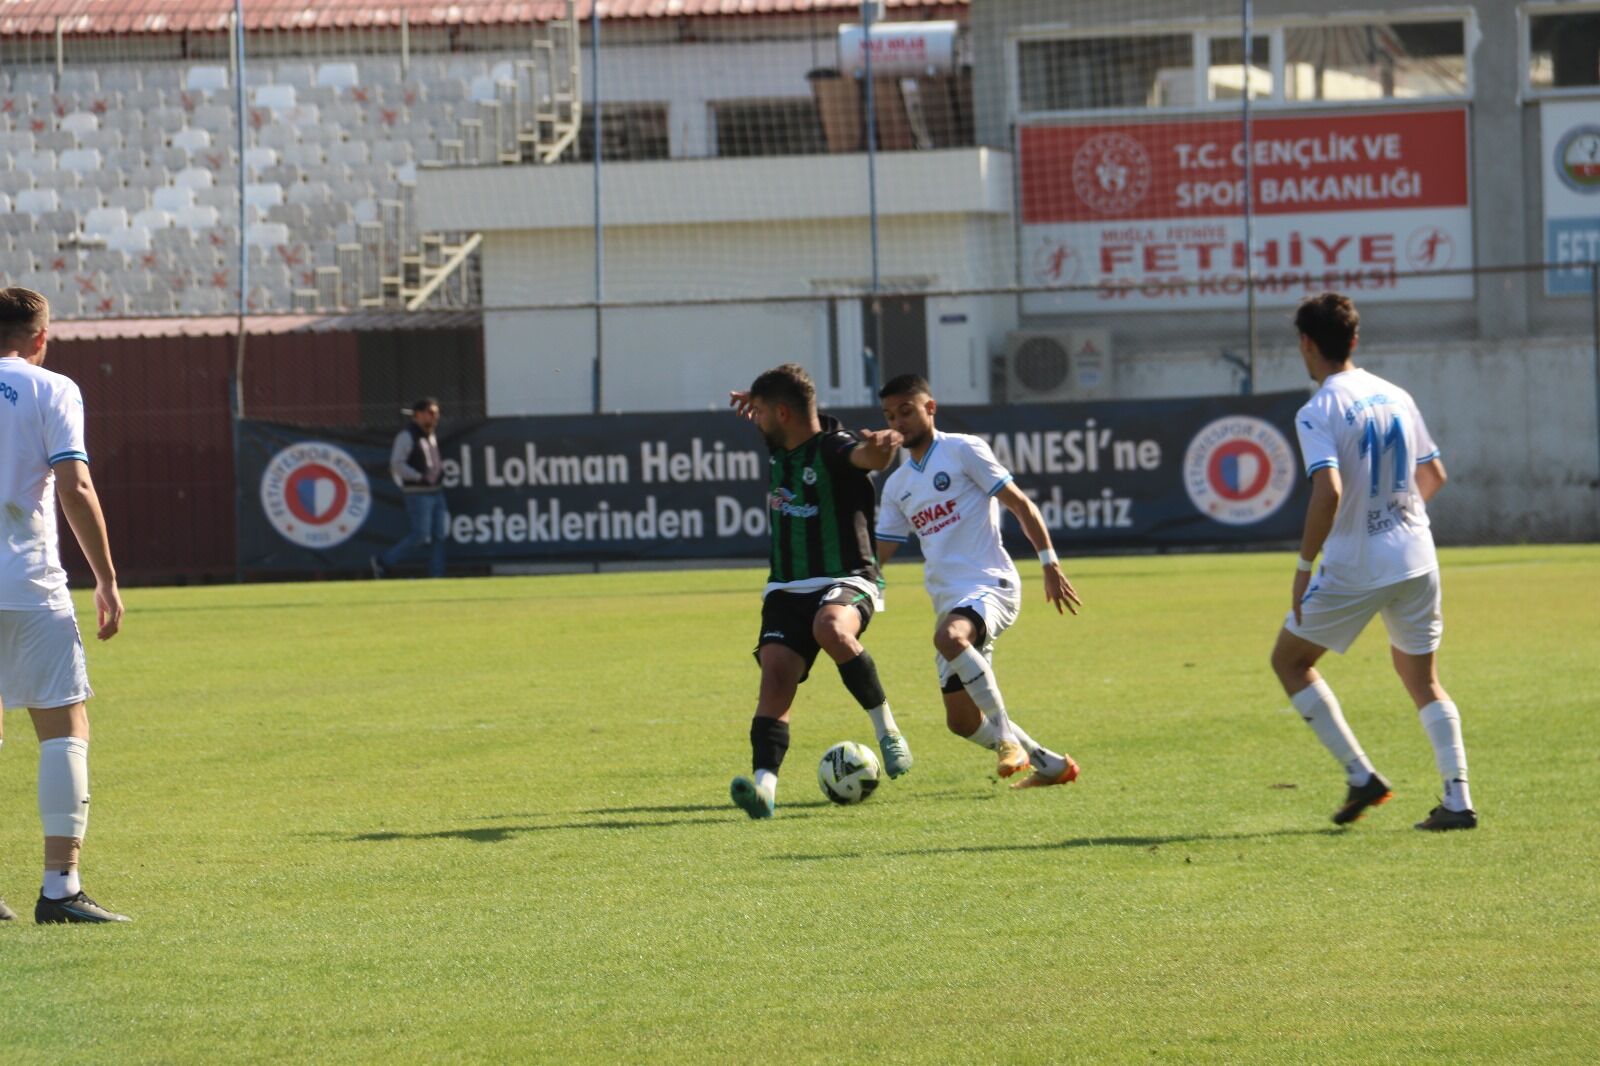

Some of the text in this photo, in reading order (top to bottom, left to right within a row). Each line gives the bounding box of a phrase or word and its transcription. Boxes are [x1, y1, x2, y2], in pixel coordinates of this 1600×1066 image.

[1174, 131, 1402, 169] T.C. GENÇLİK VE
[1259, 166, 1422, 204] BAKANLIĞI
[1100, 230, 1396, 274] FETHİYE
[441, 417, 1162, 488] el Lokman Hekim ANESİ'ne
[1359, 414, 1408, 499] 11
[911, 499, 957, 529] ESNAF
[1025, 485, 1134, 529] deriz
